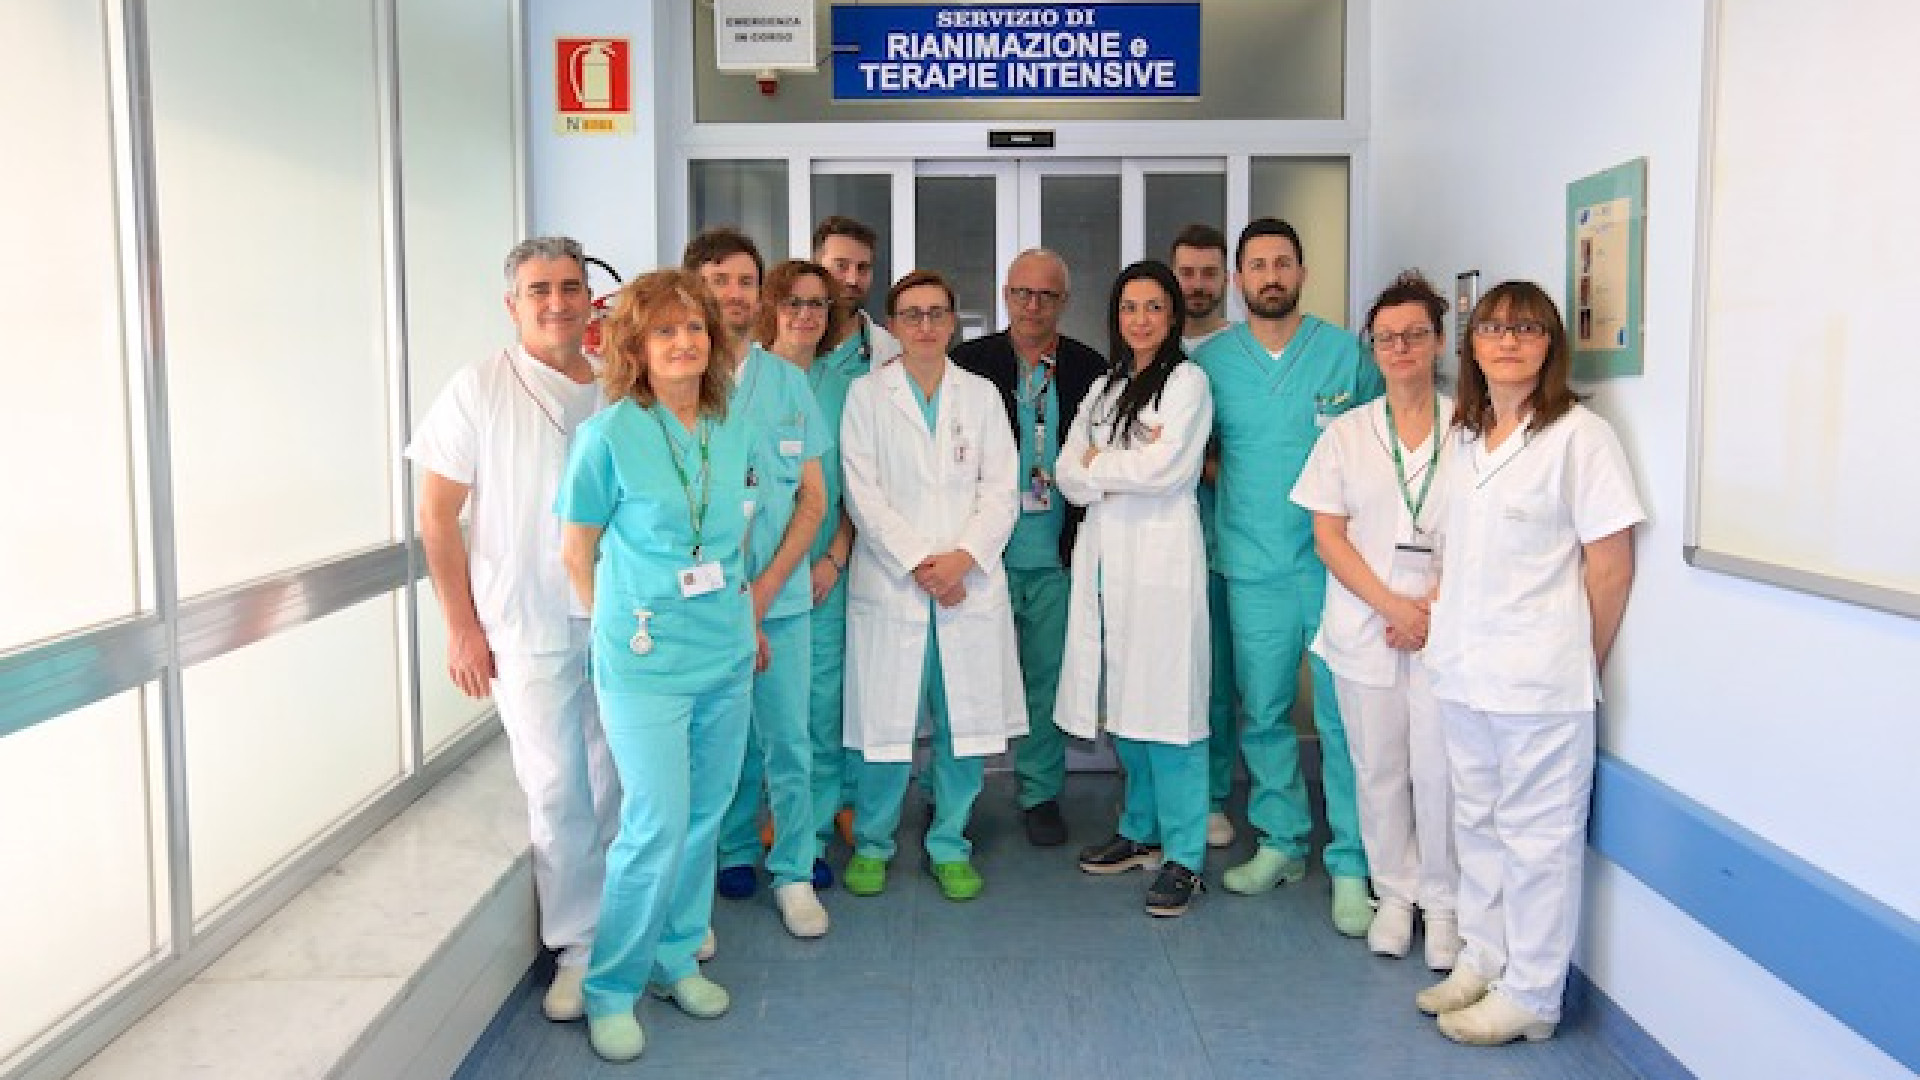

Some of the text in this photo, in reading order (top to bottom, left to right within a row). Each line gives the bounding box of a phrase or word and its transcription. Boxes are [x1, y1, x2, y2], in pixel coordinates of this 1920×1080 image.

[936, 8, 1096, 27] SERVIZIO DI
[887, 32, 1149, 60] RIANIMAZIONE e
[859, 62, 1176, 91] TERAPIE INTENSIVE
